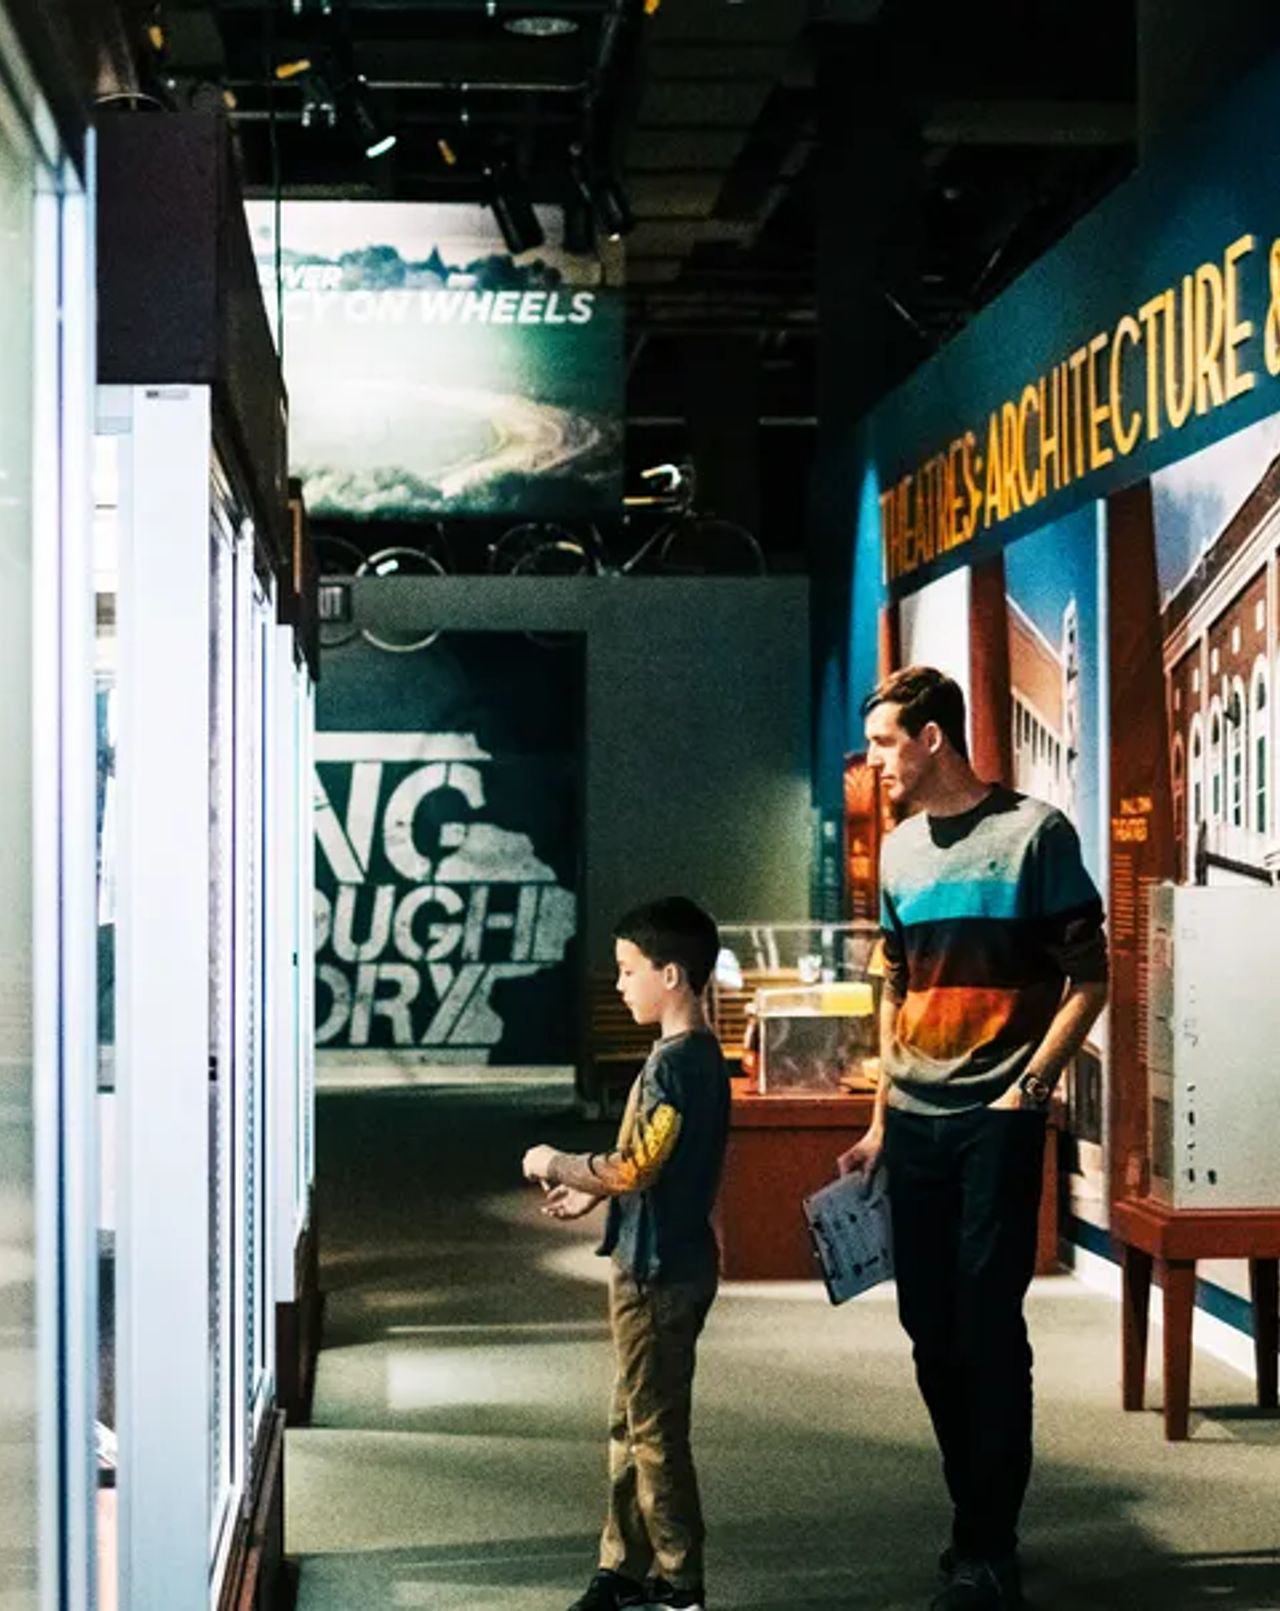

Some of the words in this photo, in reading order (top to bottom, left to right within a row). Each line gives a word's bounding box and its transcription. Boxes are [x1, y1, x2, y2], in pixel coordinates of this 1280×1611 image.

[345, 291, 410, 323] ON
[419, 291, 595, 325] WHEELS
[984, 233, 1255, 529] ARCHITECTURE
